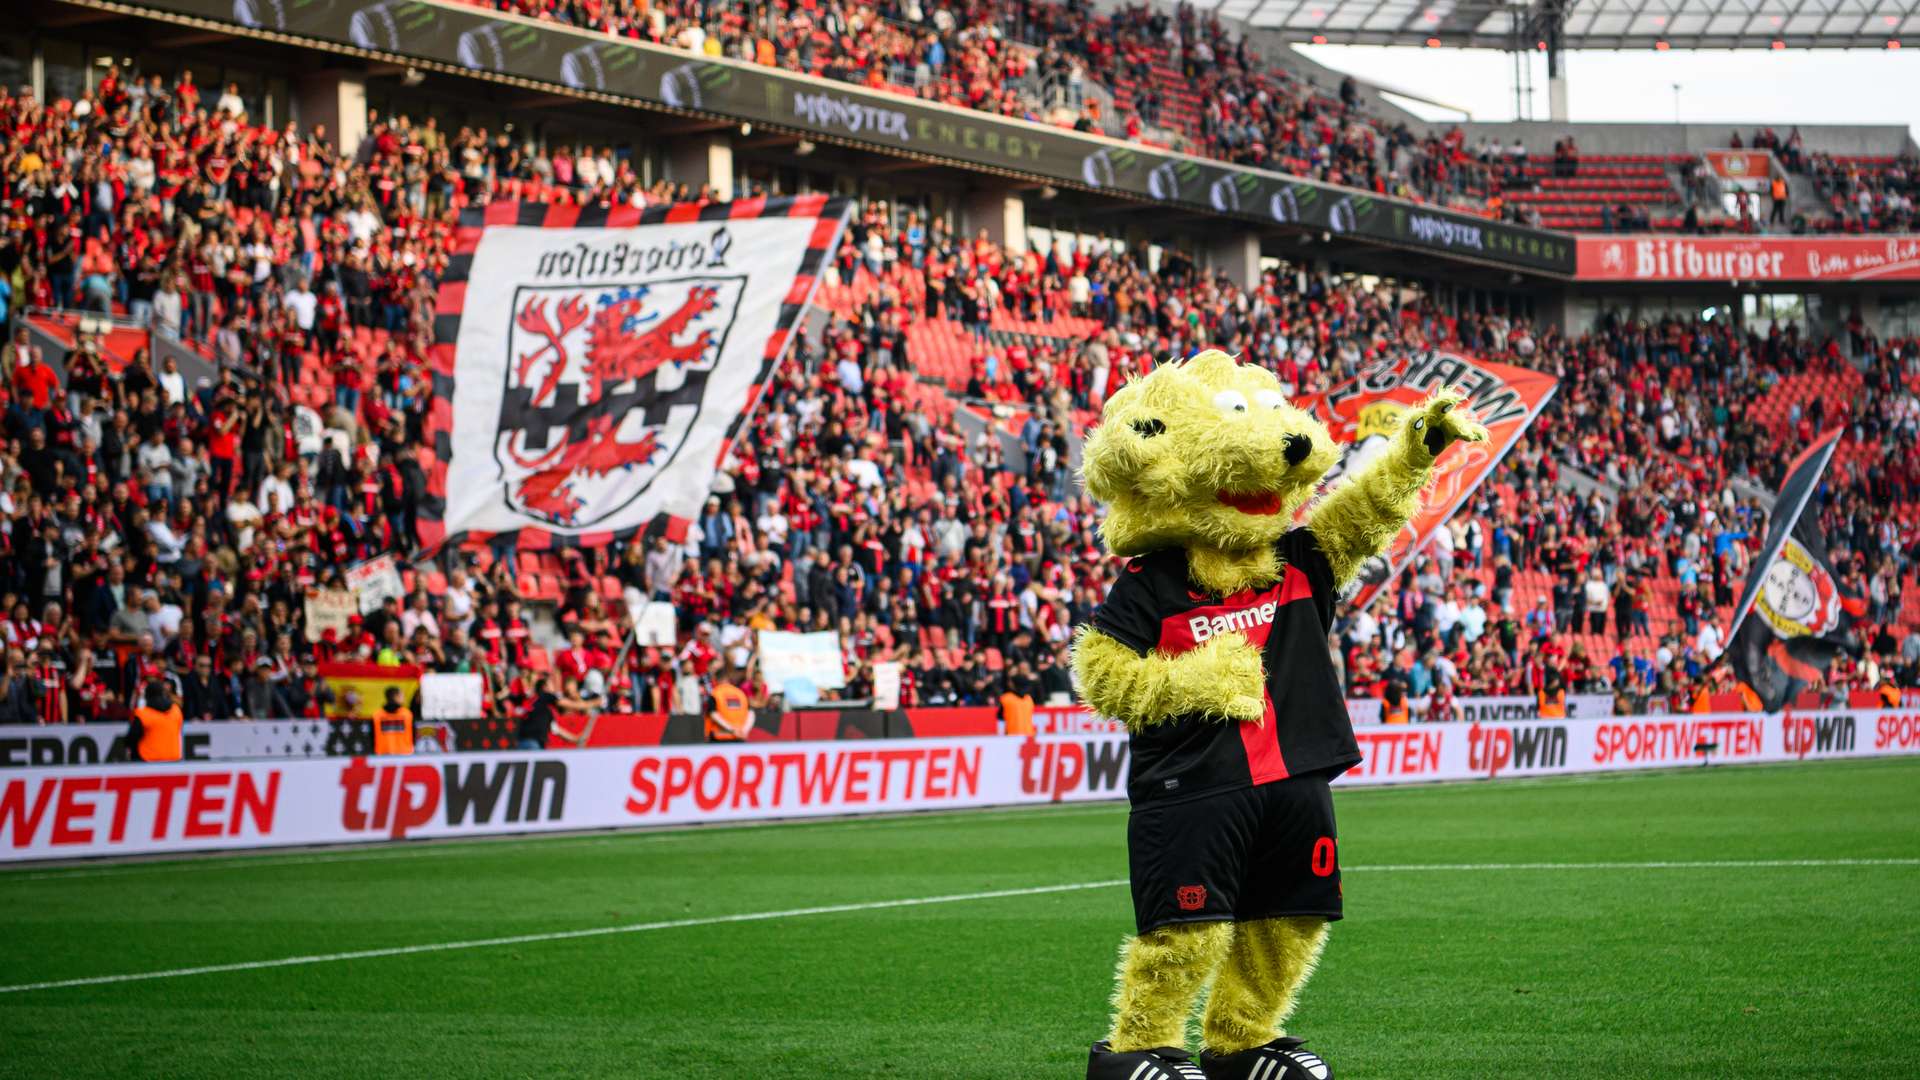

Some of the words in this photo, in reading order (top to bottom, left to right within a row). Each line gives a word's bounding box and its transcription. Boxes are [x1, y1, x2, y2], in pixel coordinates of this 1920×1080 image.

[794, 91, 909, 141] MONSTER
[916, 117, 1042, 160] ENERGY
[1410, 214, 1483, 250] MONSTER
[1487, 230, 1566, 260] ENERGY
[1635, 238, 1783, 278] Bitburger
[1593, 718, 1764, 764] SPORTWETTEN
[625, 746, 983, 815] SPORTWETTEN
[1311, 836, 1339, 877] 0
